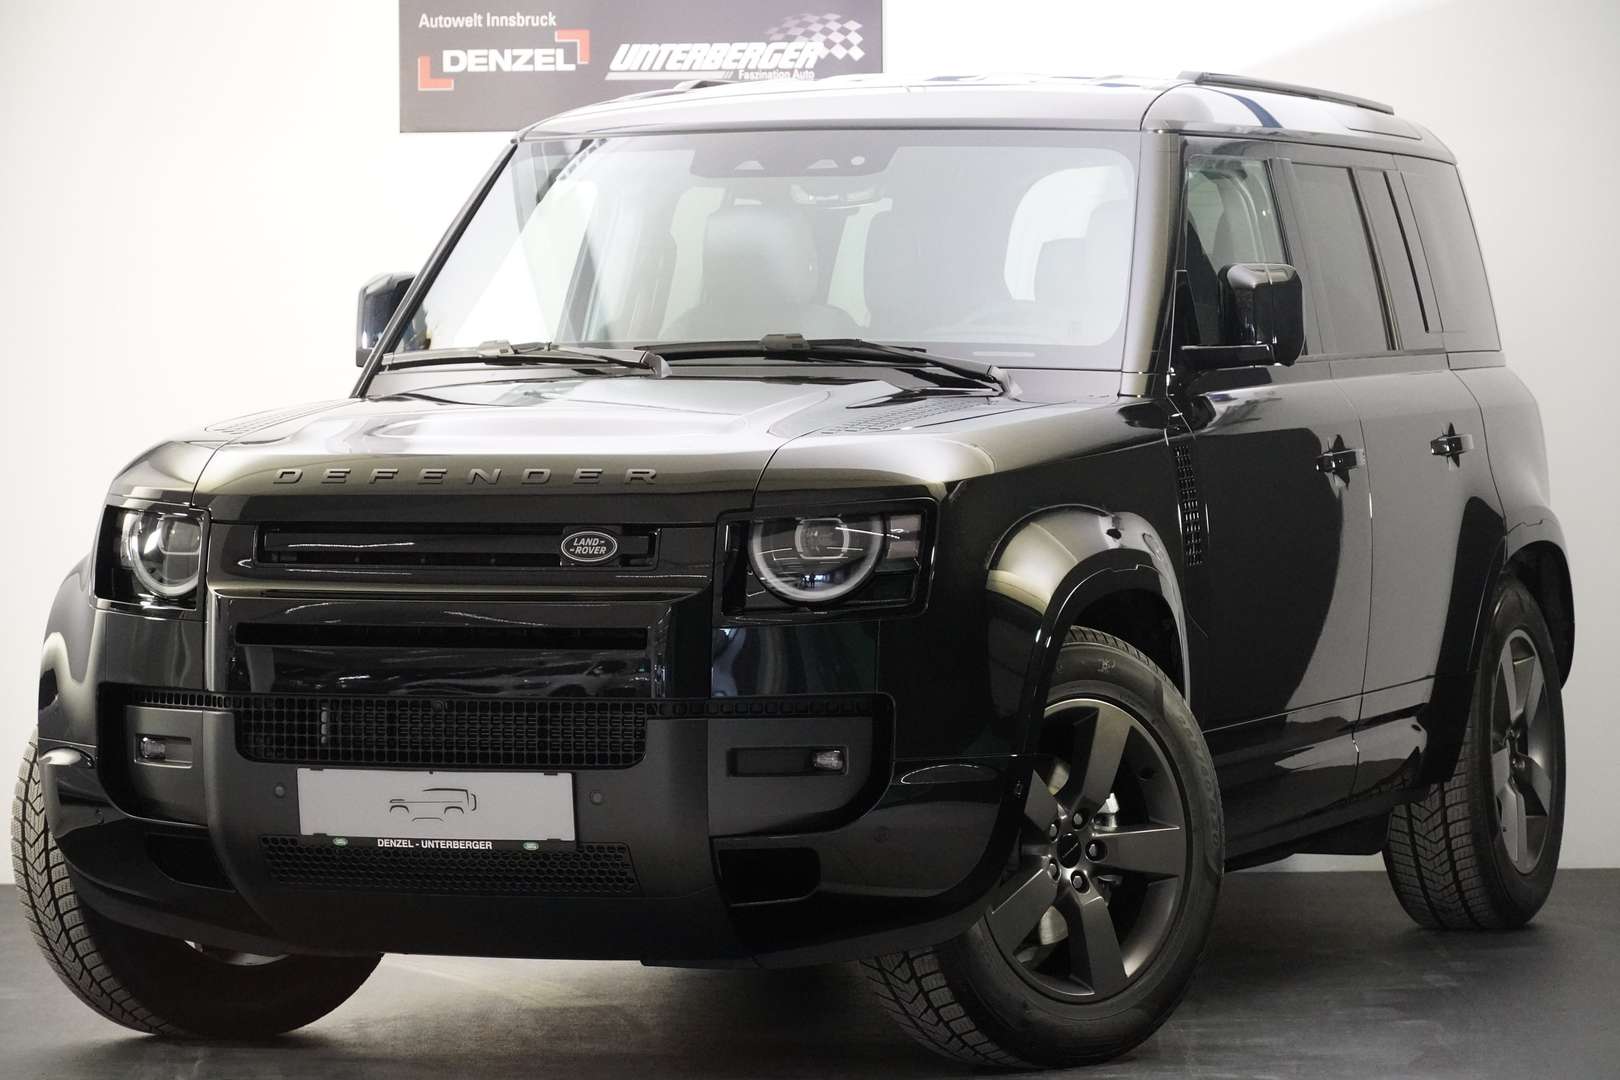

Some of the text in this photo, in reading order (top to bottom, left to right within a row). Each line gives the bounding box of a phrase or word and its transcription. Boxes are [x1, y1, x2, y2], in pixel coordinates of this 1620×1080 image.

[418, 12, 557, 28] Autowelt Innsbruck
[442, 48, 577, 73] DENZEL
[608, 41, 824, 72] UNTERBERGER
[738, 68, 816, 81] Faszination Auto
[272, 467, 658, 486] DEFENDER
[377, 838, 415, 848] DENZEL
[421, 839, 493, 850] UNTERBERGER
